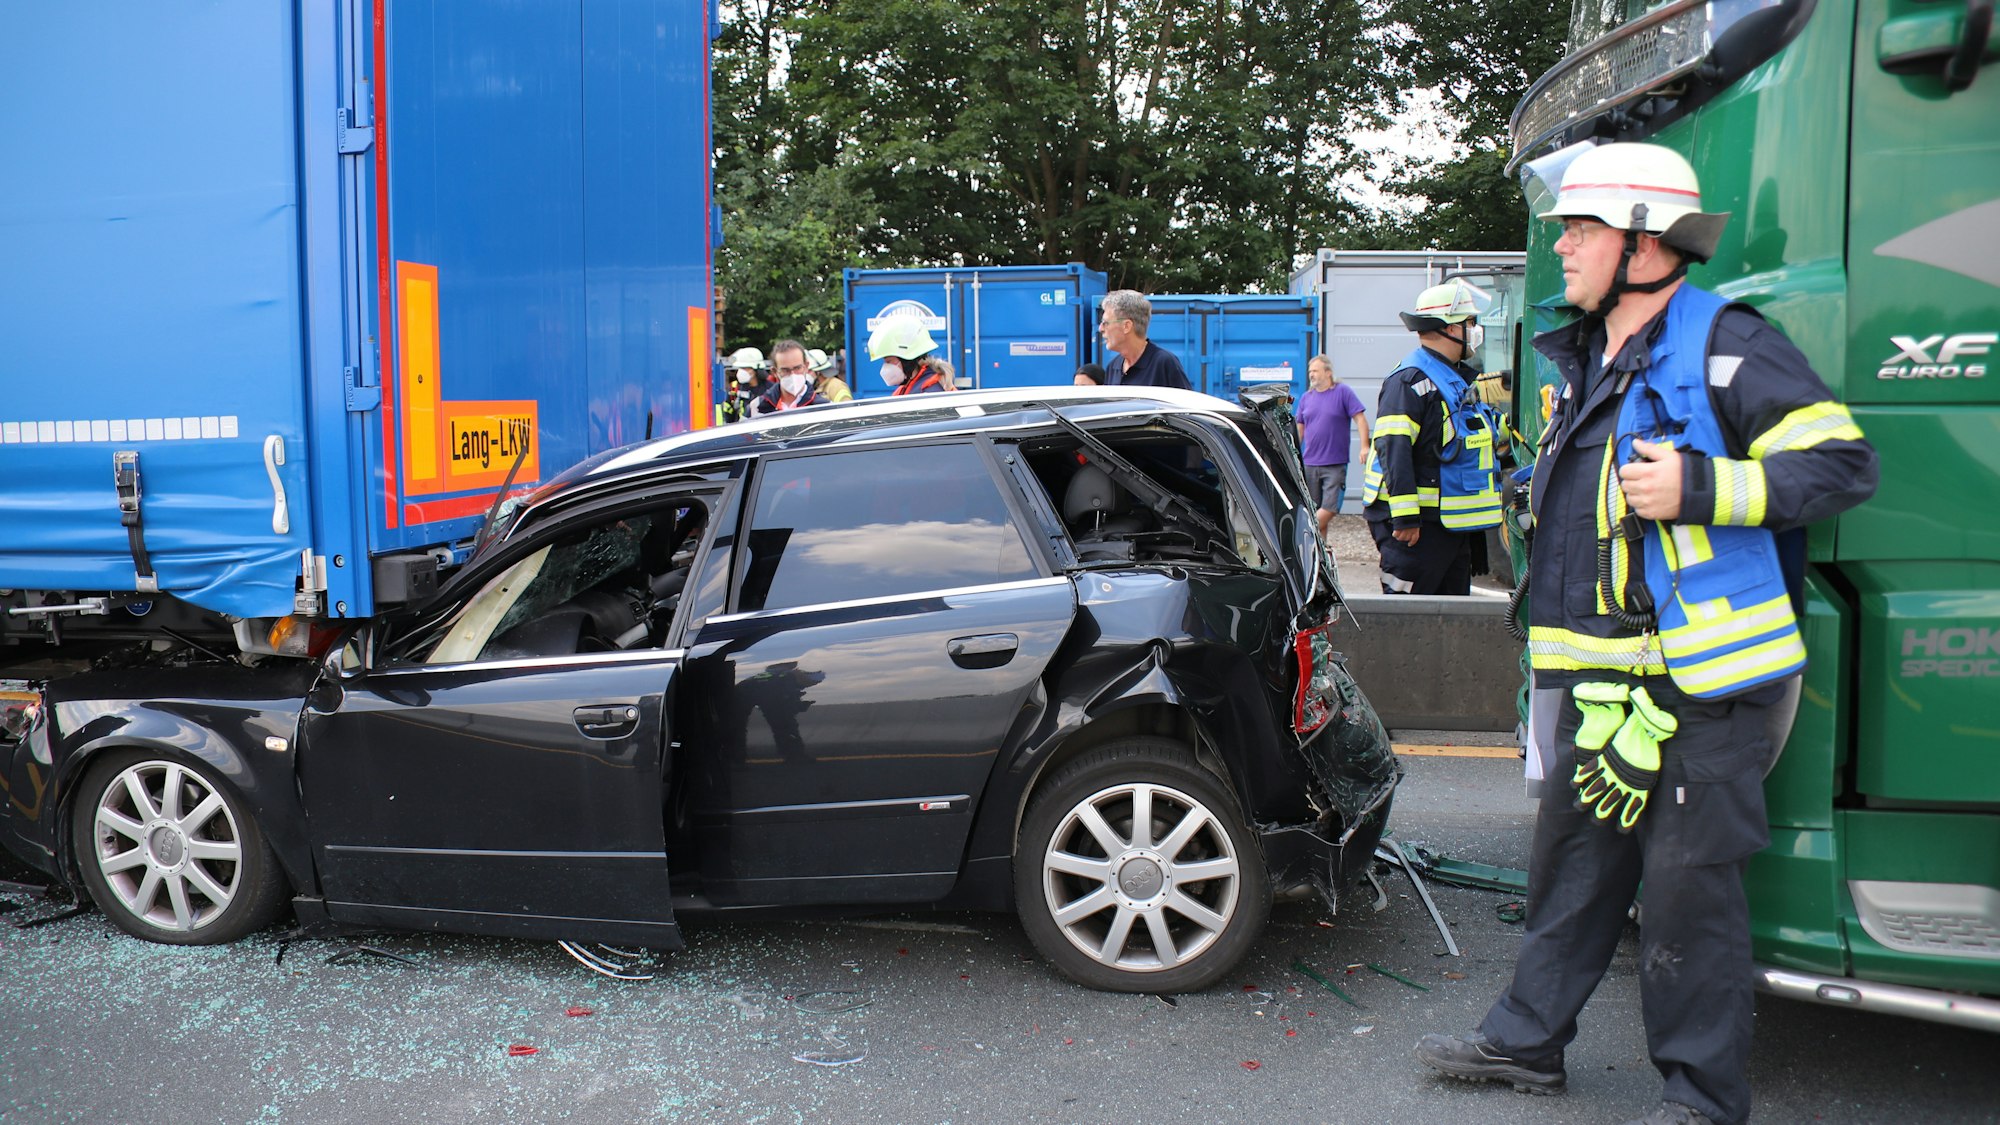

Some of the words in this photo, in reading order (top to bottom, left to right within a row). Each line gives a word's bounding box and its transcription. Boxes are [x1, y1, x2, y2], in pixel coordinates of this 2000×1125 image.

[1040, 293, 1053, 302] GL
[1881, 332, 1998, 365] XF
[1876, 365, 1961, 379] EURO
[1963, 364, 1986, 378] 6
[451, 418, 531, 469] Lang-LKW
[1901, 627, 2000, 656] HOK
